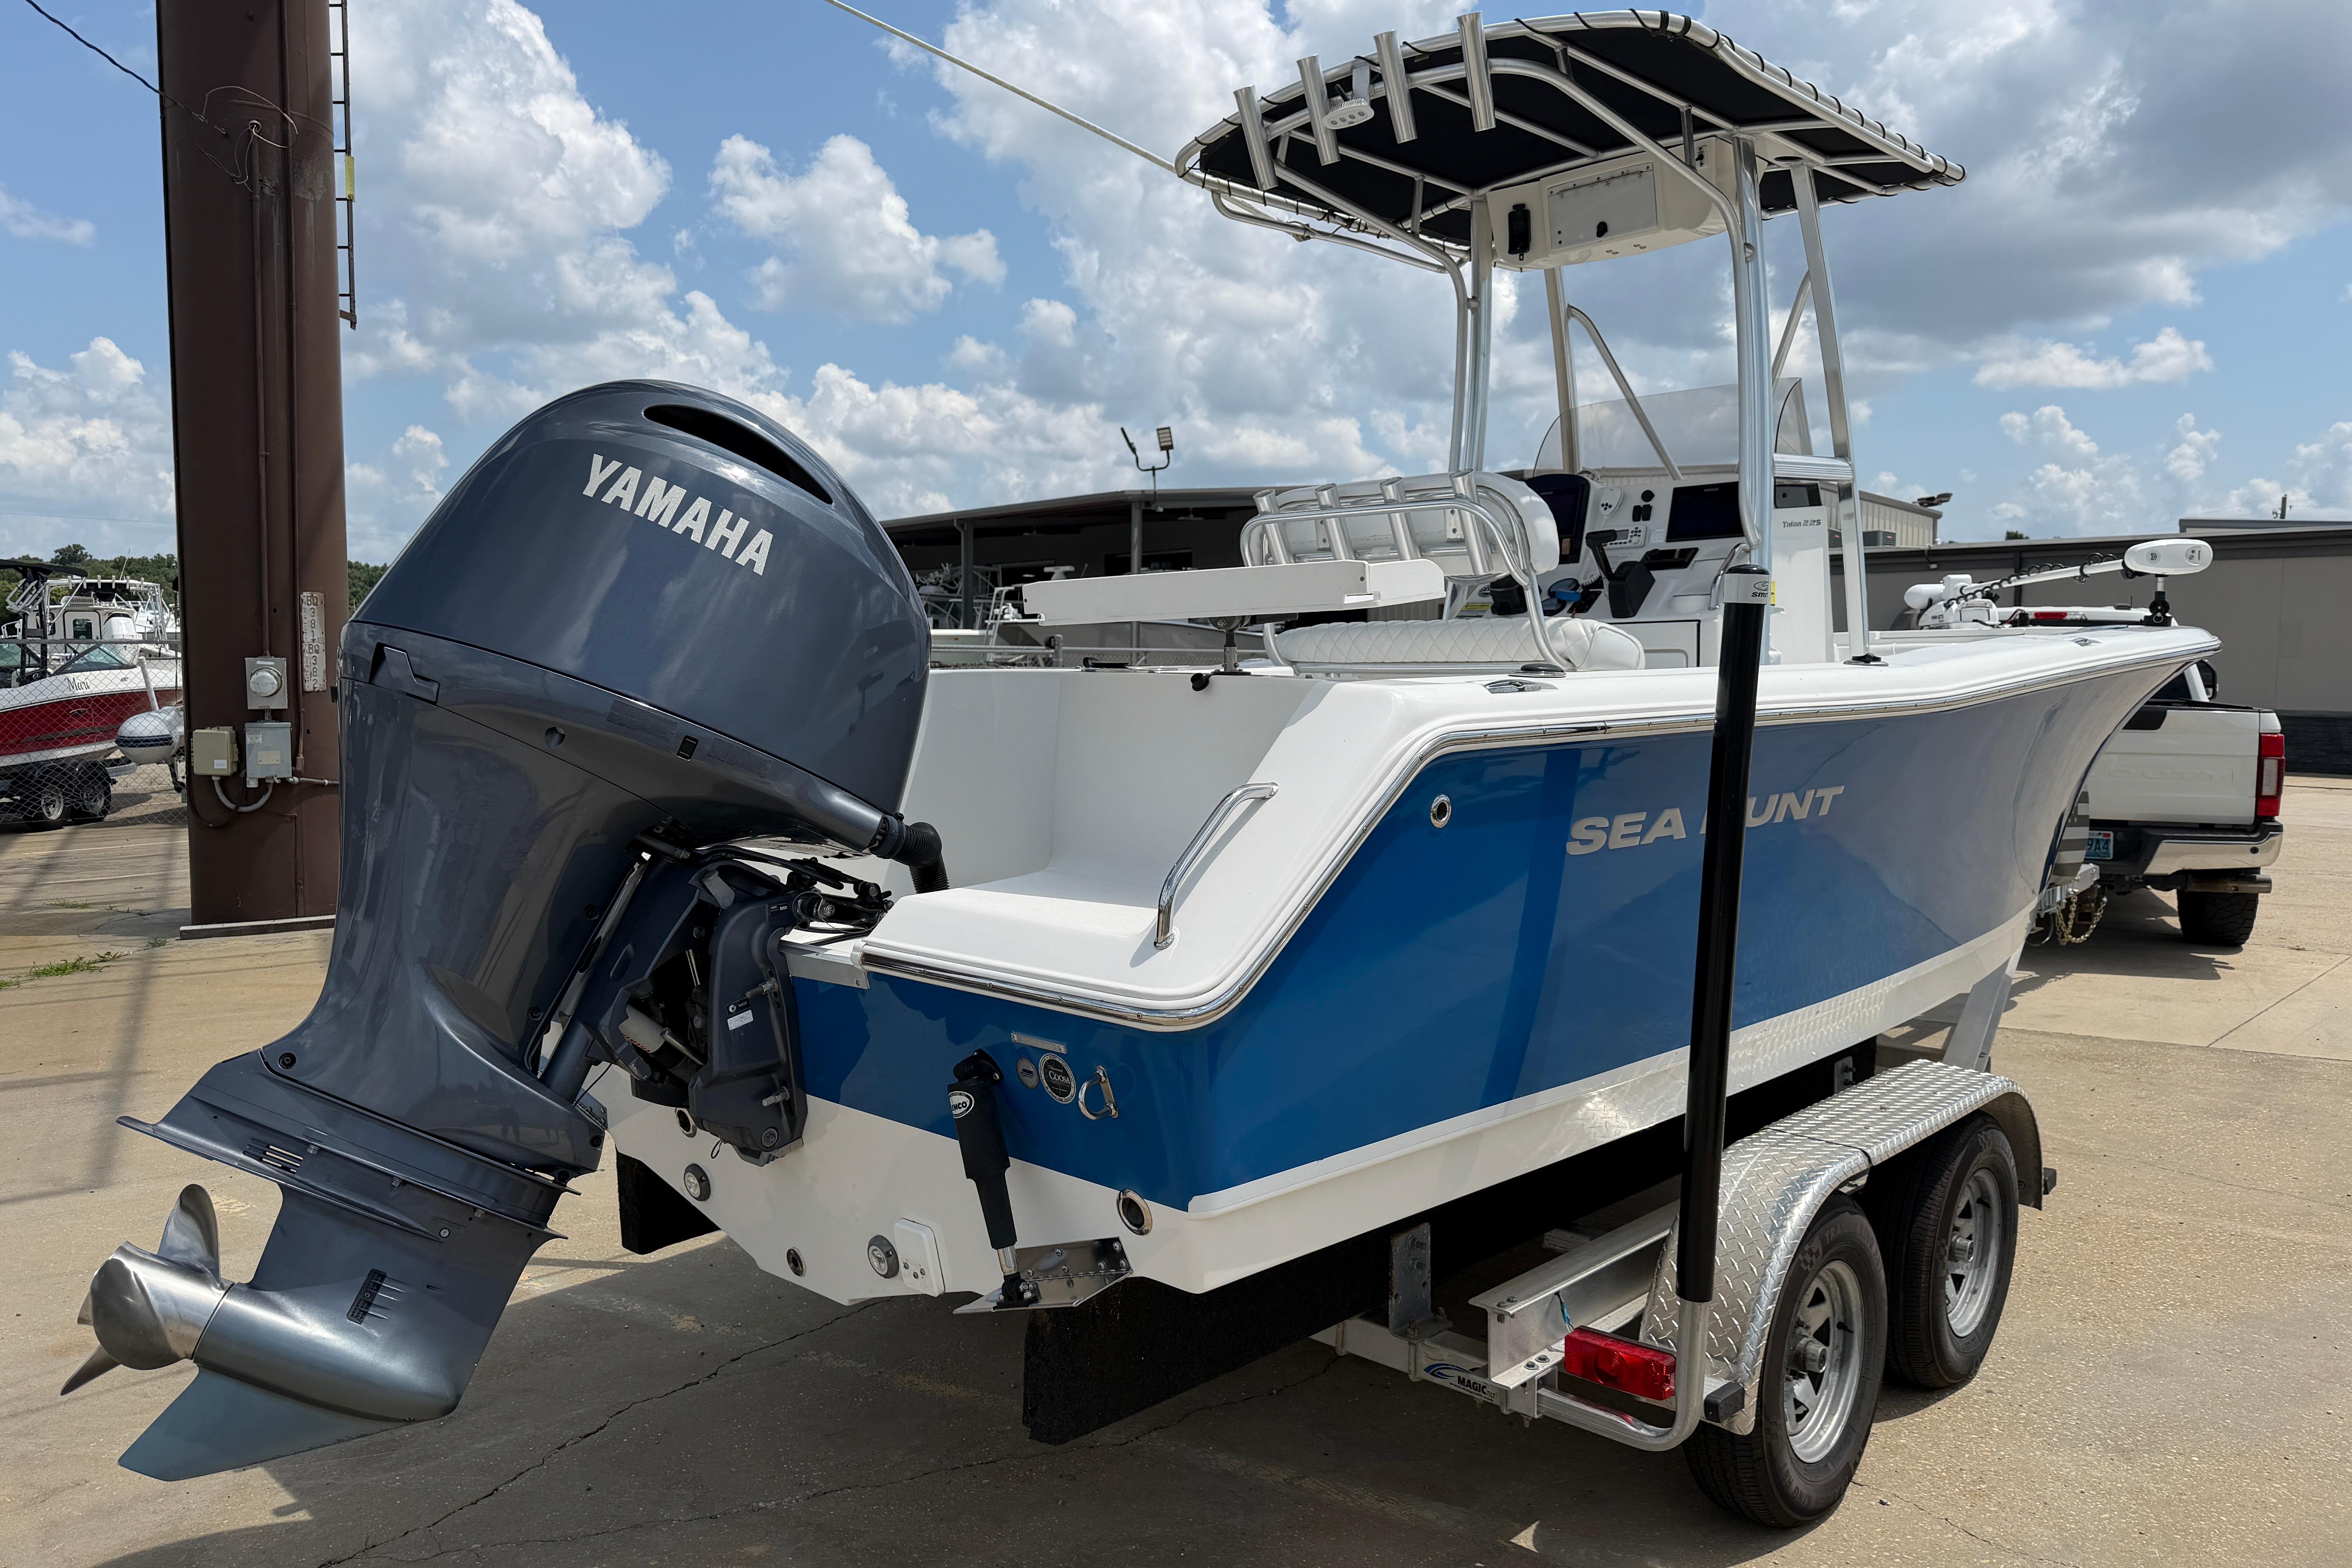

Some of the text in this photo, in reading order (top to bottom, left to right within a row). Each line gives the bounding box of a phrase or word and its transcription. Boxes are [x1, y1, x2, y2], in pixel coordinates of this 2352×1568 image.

[583, 454, 773, 576] YAMAHA
[307, 596, 318, 605] BQ
[309, 644, 320, 654] BQ
[64, 677, 90, 692] Mari
[1566, 785, 1845, 855] SEA UNT
[952, 1101, 967, 1111] ENCO
[1458, 1375, 1496, 1398] MAGIC TILT
